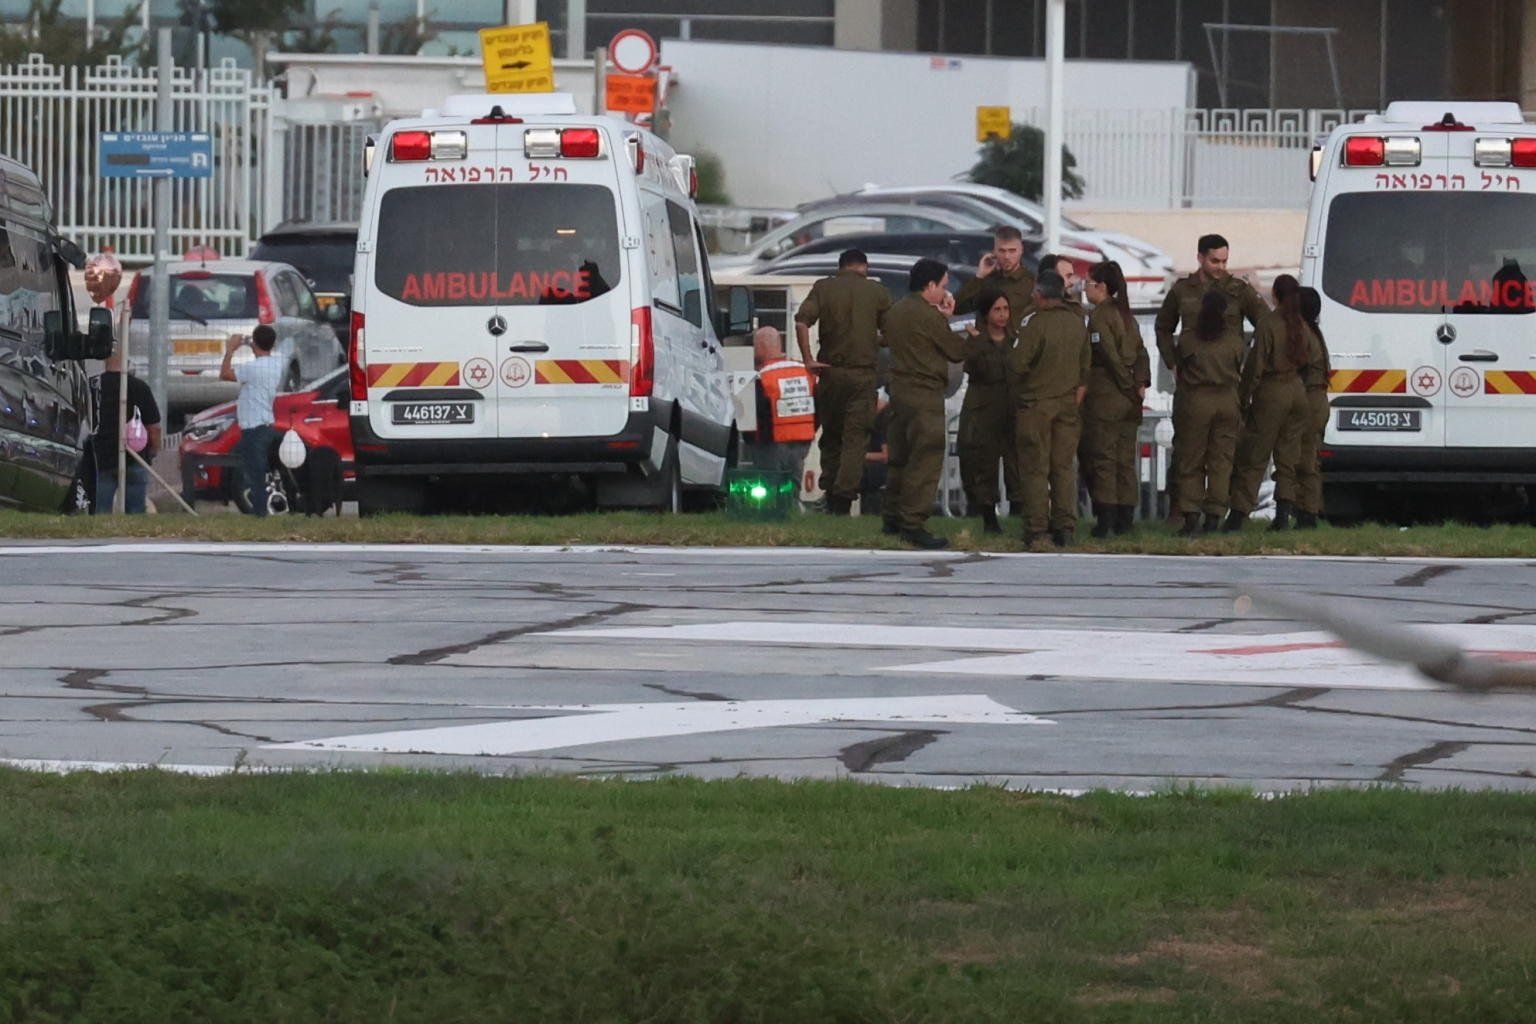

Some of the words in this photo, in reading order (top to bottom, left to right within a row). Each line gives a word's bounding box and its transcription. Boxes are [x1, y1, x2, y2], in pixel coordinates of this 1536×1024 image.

[123, 134, 159, 142] עובדים
[160, 133, 186, 143] חניון
[424, 165, 513, 183] הרפואה
[528, 162, 569, 182] חיל
[1480, 170, 1521, 190] חיל
[1375, 173, 1465, 190] הרפואה
[401, 269, 592, 300] AMBULANCE
